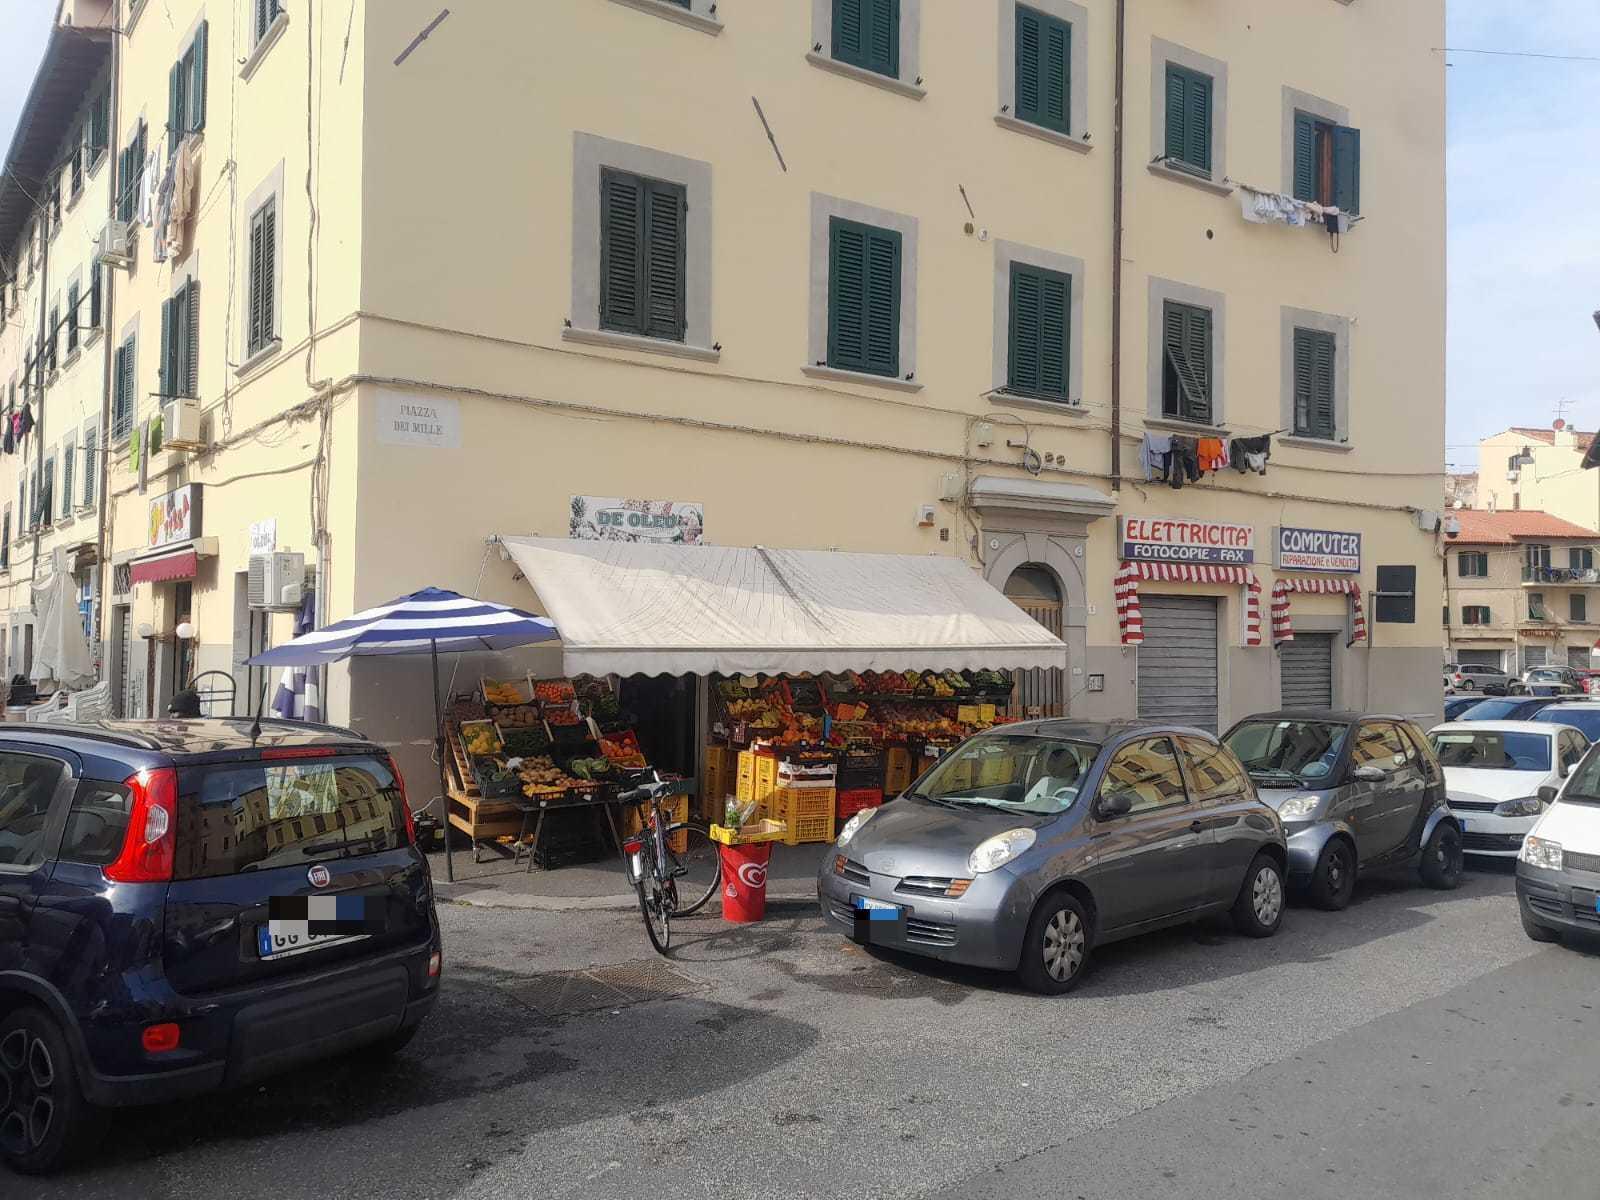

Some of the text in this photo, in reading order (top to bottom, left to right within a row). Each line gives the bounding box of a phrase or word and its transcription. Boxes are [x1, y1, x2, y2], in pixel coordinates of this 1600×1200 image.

[400, 404, 437, 419] PIAZZA
[393, 420, 444, 435] DEI MILLE
[597, 510, 624, 526] DE
[1126, 519, 1252, 546] ELETTRICITA'
[1281, 530, 1358, 555] COMPUTER
[1133, 545, 1210, 560] FOTOCOPIE
[1220, 549, 1245, 561] FAX
[1282, 553, 1325, 568] RIPARAZIONE
[1330, 556, 1357, 569] VENDITA
